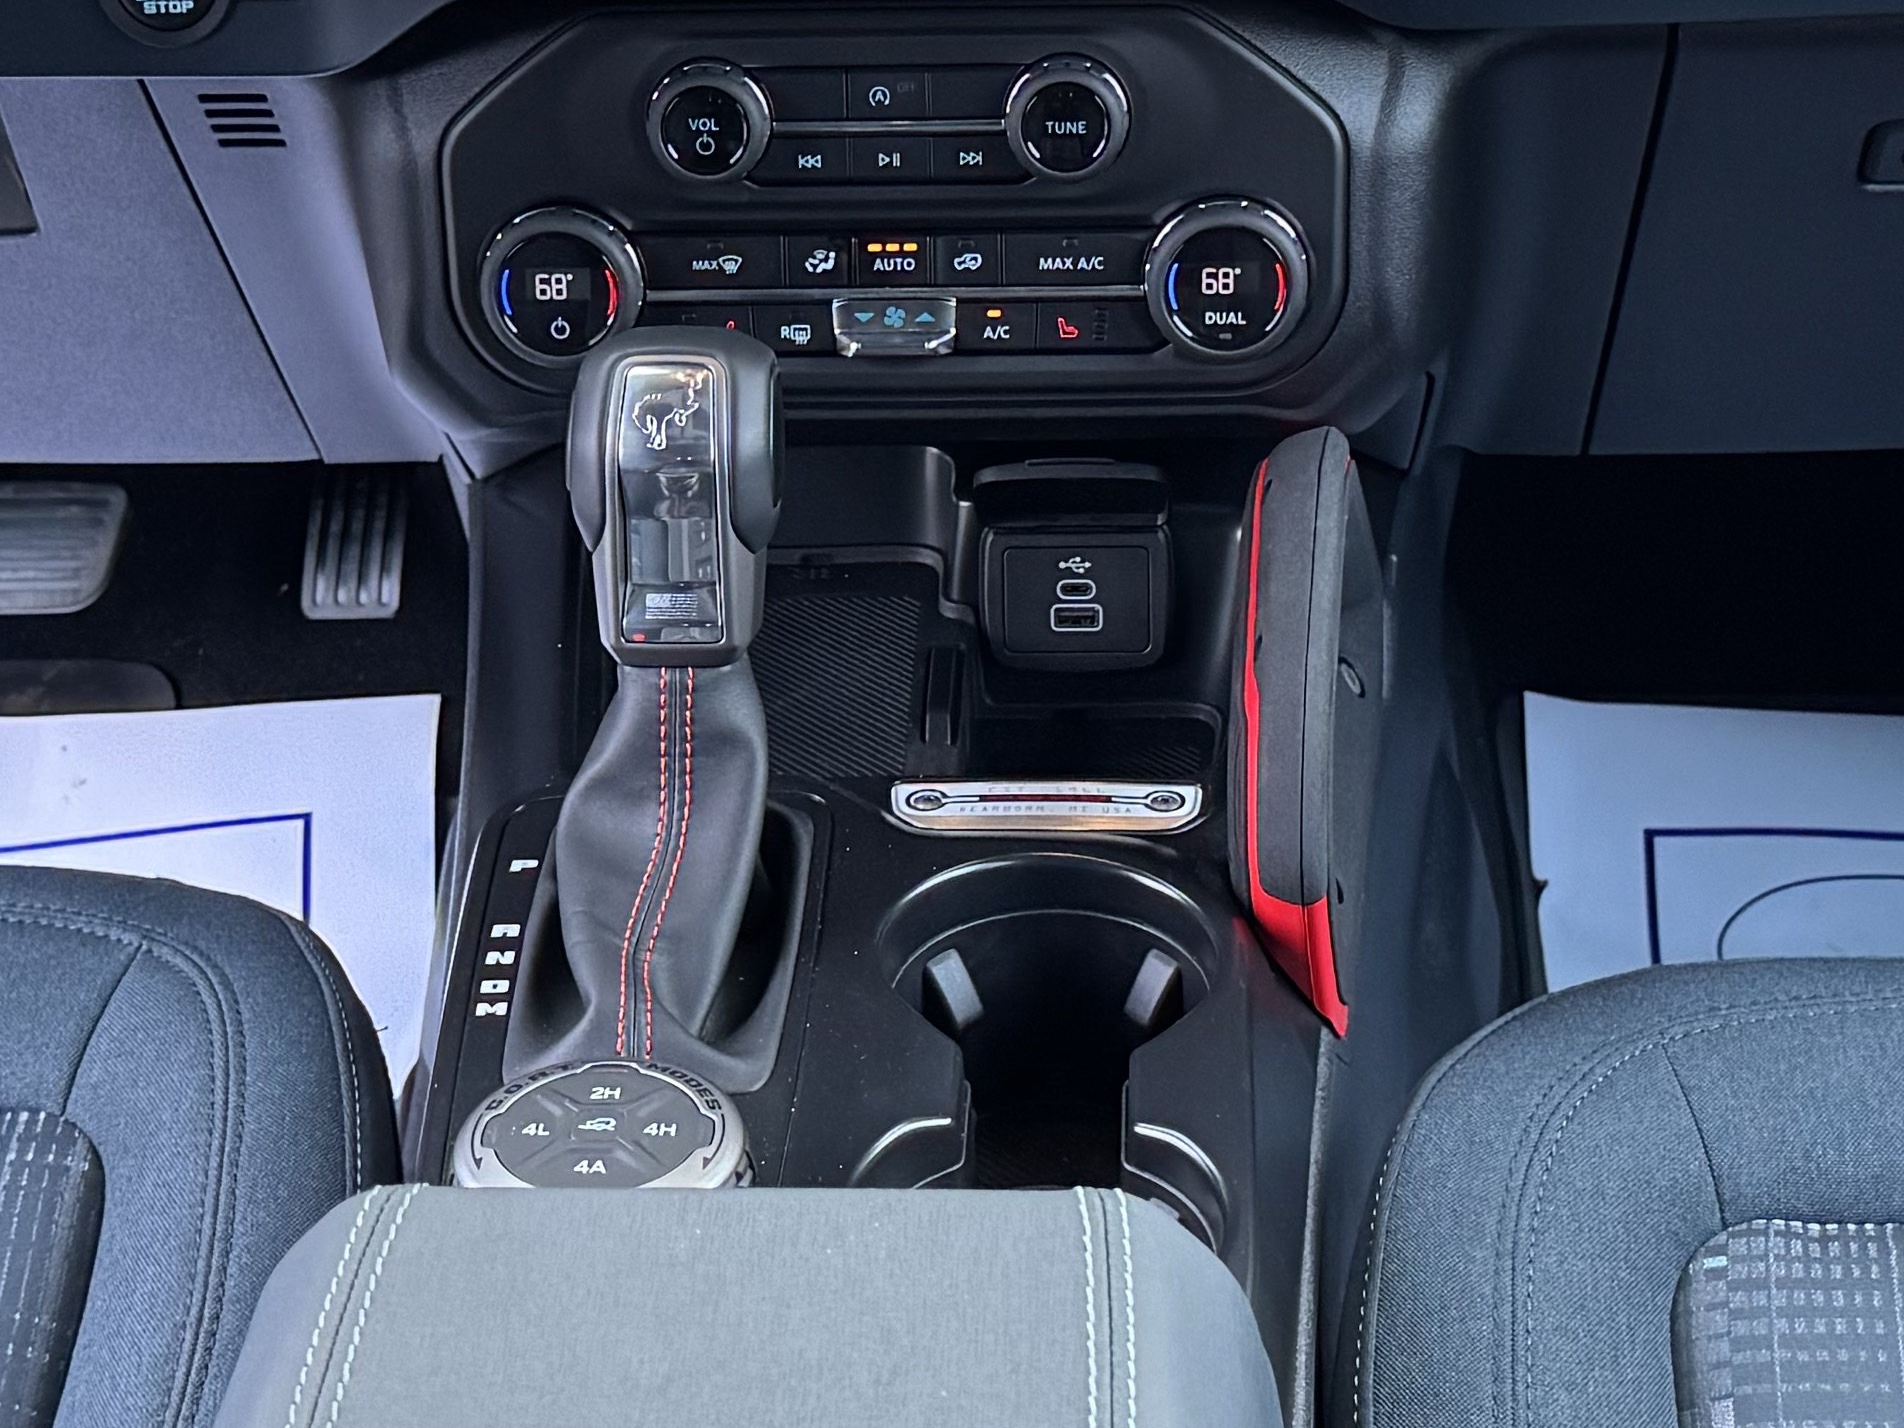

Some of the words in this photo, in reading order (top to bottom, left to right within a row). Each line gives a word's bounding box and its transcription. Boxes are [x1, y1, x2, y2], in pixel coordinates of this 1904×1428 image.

[143, 0, 195, 14] STOP
[689, 117, 720, 132] VOL
[1045, 120, 1087, 135] TUNE
[692, 258, 718, 271] MAX
[873, 257, 916, 271] AUTO
[1039, 255, 1074, 270] MAX
[1077, 255, 1104, 271] A/C
[1204, 311, 1247, 326] DUAL
[983, 325, 1011, 340] A/C
[509, 858, 539, 873] P
[490, 923, 521, 938] R
[485, 950, 515, 965] N
[480, 979, 510, 994] D
[475, 1002, 509, 1017] M
[590, 1086, 621, 1100] 2H
[647, 1062, 722, 1111] MODES
[521, 1122, 550, 1136] 4L
[643, 1122, 677, 1137] 4H
[573, 1159, 607, 1174] 4A
